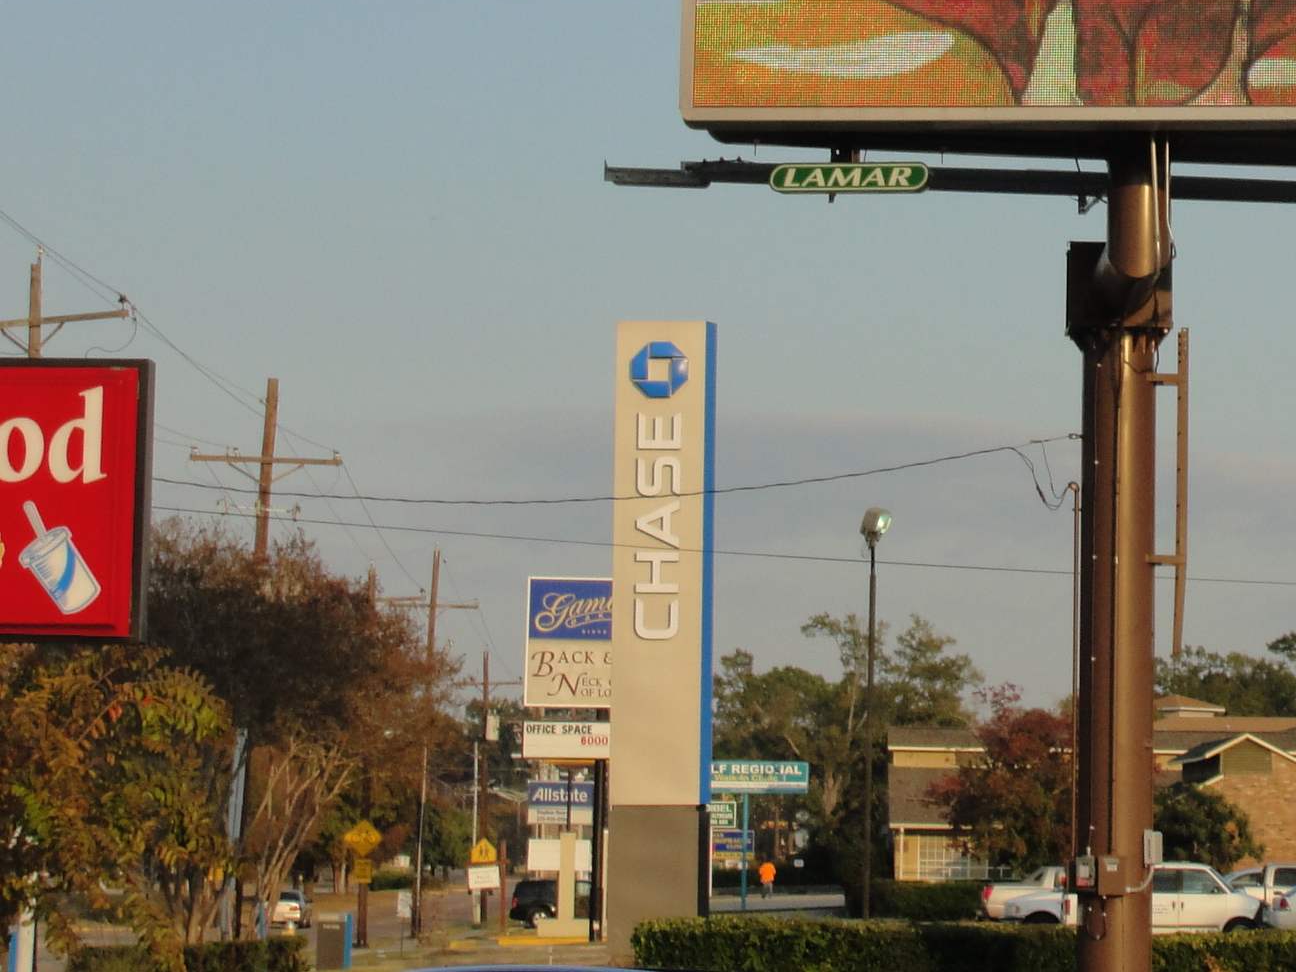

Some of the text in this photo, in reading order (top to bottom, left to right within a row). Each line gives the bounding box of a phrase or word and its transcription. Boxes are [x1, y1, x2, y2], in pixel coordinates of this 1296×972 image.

[783, 166, 913, 187] LAMAR
[0, 386, 108, 484] od
[633, 411, 683, 641] CHASE
[531, 650, 594, 677] BACK
[547, 671, 602, 697] NECK
[580, 688, 594, 697] OF
[526, 724, 593, 734] OFFICE SPACE
